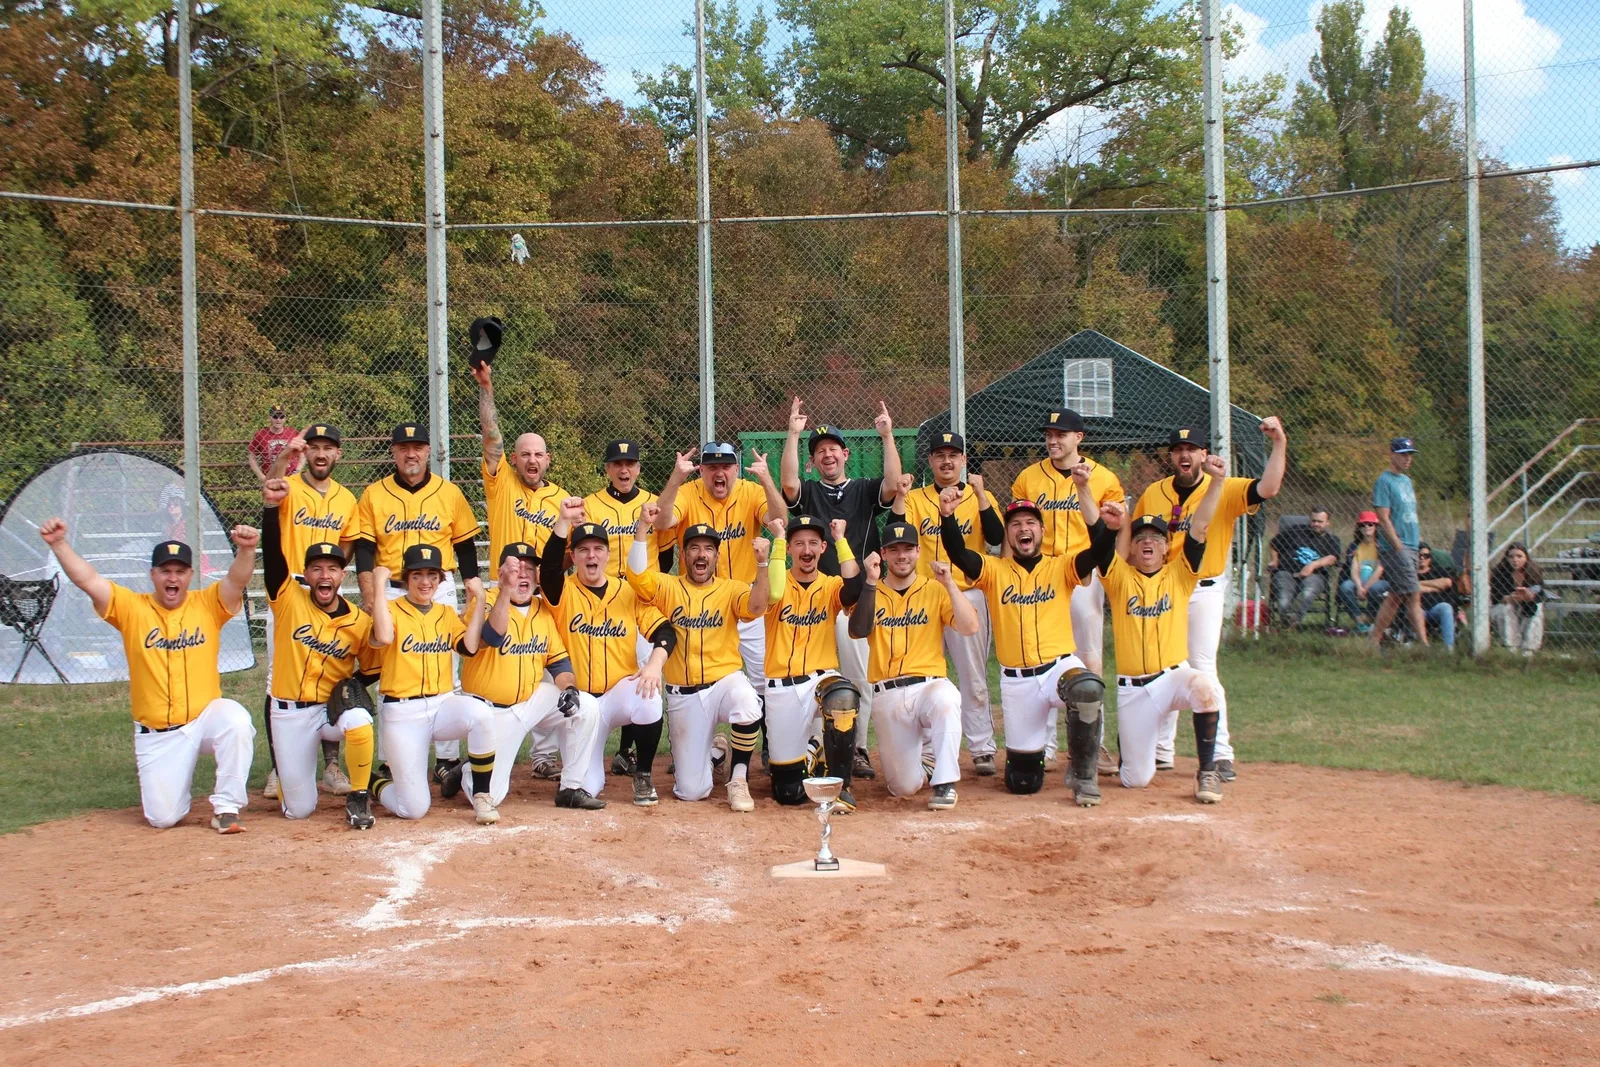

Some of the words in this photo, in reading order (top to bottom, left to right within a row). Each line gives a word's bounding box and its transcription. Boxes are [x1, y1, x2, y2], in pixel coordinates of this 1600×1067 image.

[1050, 413, 1060, 424] W
[404, 426, 416, 438] W
[816, 427, 829, 435] W
[1178, 429, 1190, 439] W
[943, 433, 953, 443] W
[618, 443, 630, 453] W
[1036, 493, 1080, 511] Canniba
[384, 514, 442, 534] Cannibals
[799, 516, 811, 525] W
[582, 525, 594, 535] W
[696, 525, 708, 534] W
[893, 526, 905, 538] W
[420, 548, 432, 560] W
[516, 544, 528, 555] W
[1001, 583, 1056, 605] Cannibals
[670, 605, 724, 629] Cannibals
[875, 607, 929, 627] Cannibals
[569, 613, 628, 638] Cannibals
[144, 626, 206, 651] Cannibals
[293, 624, 352, 660] Cannibal
[401, 632, 452, 653] Cannibal
[499, 634, 549, 656] Cannibal
